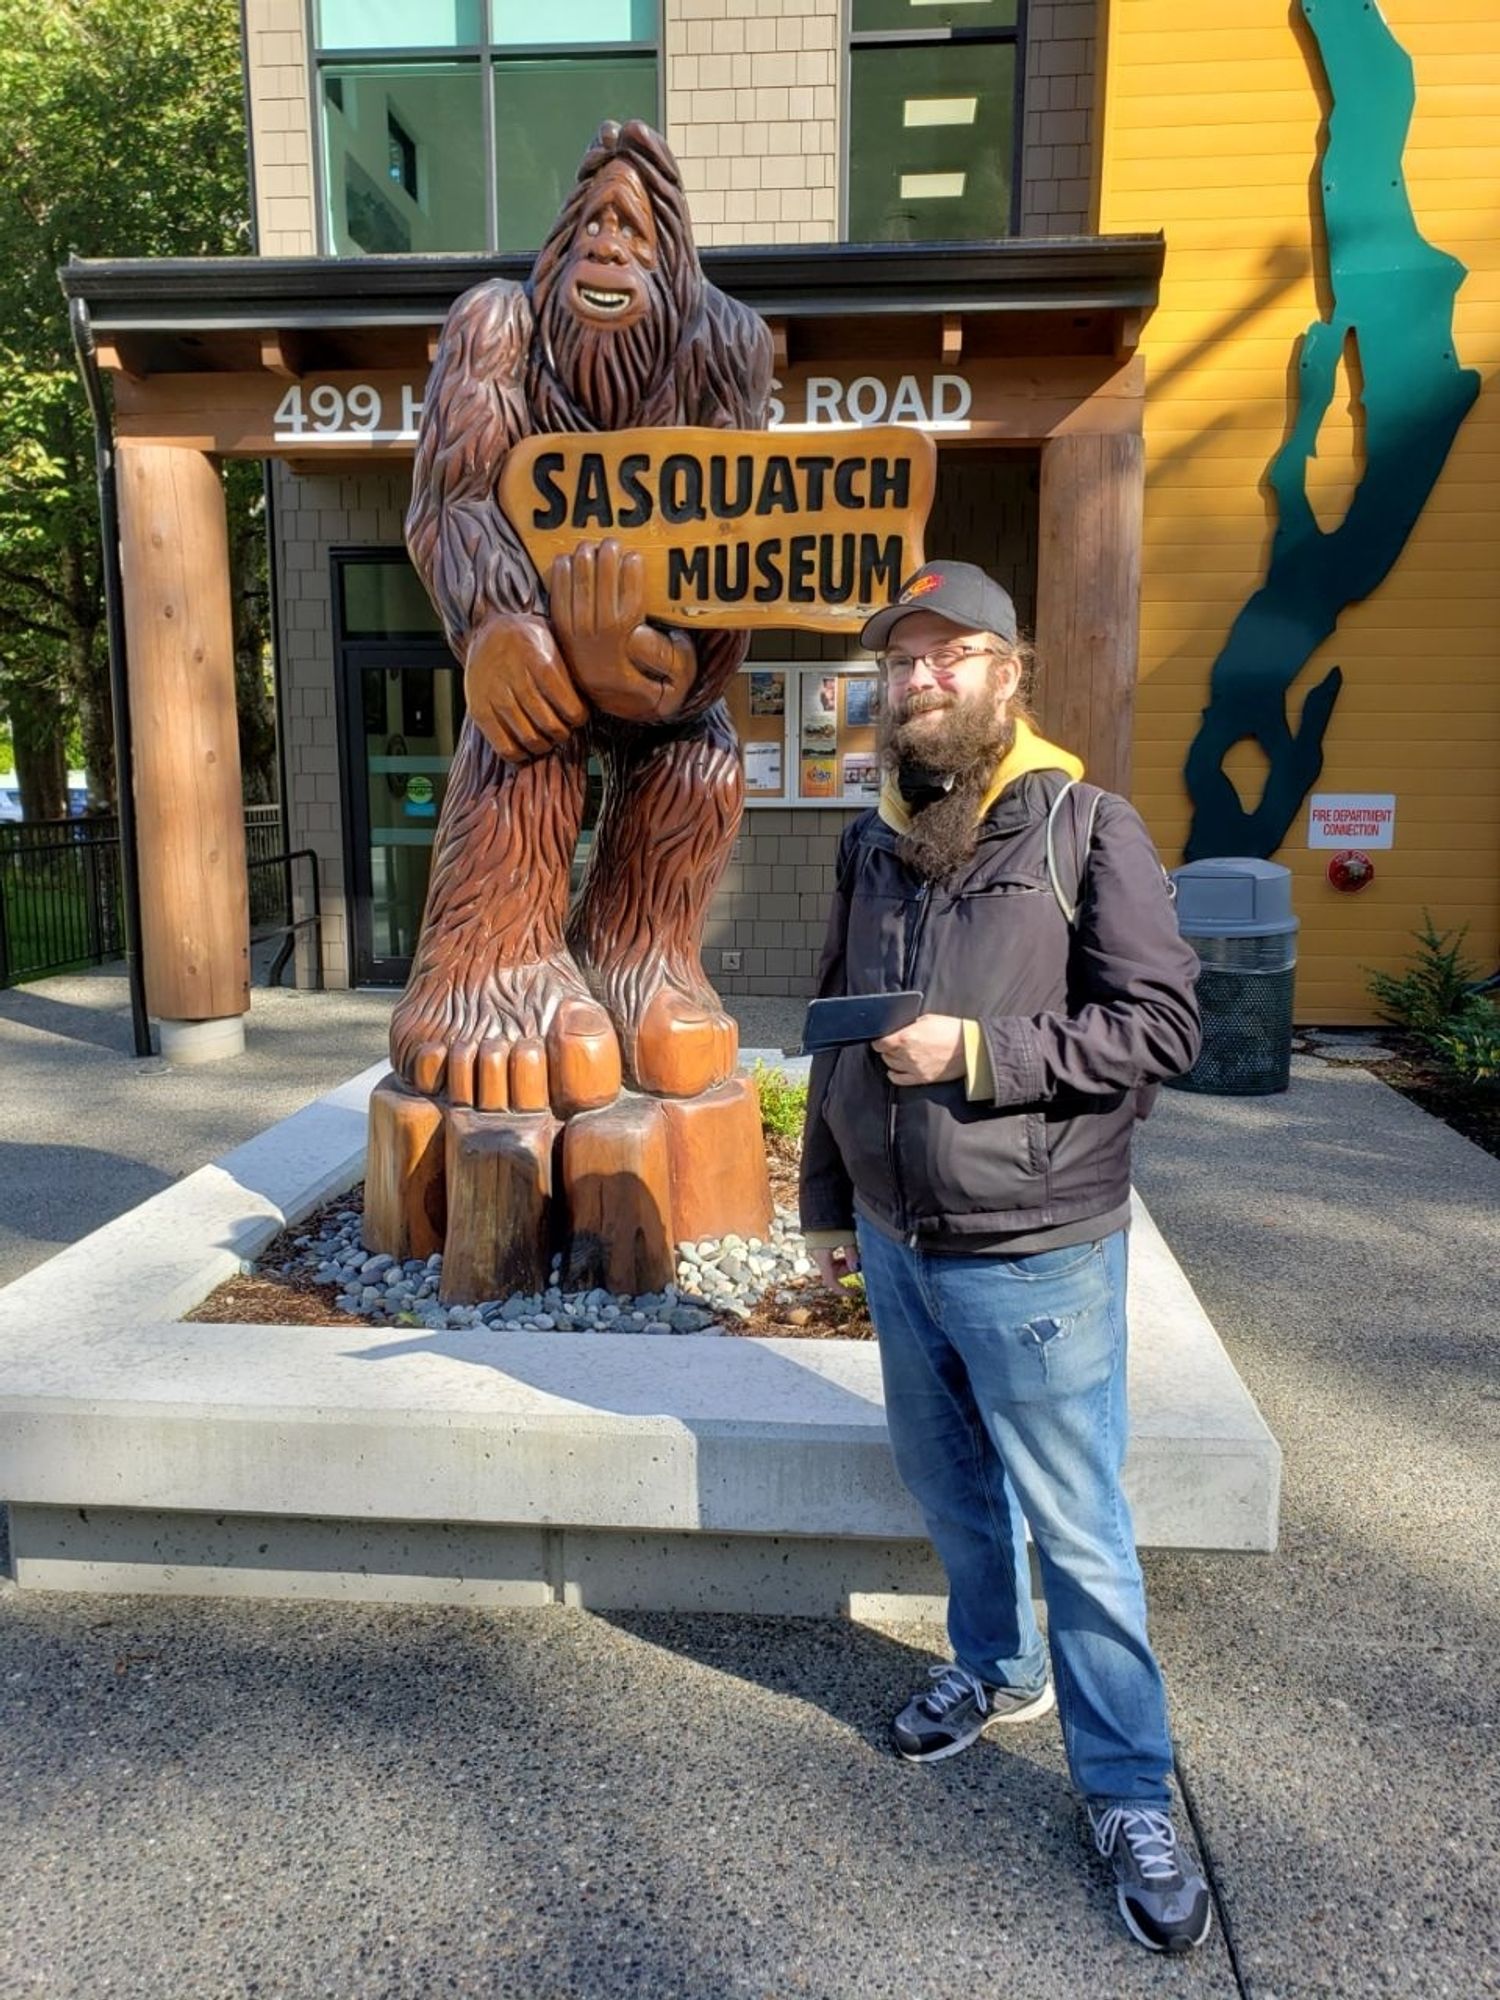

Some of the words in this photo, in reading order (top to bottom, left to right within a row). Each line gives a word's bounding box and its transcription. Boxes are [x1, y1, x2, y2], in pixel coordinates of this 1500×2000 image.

[274, 385, 381, 433] 499
[806, 375, 972, 425] ROAD
[532, 452, 911, 530] SASQUATCH
[667, 533, 904, 604] MUSEUM
[1312, 809, 1332, 822] FIRE
[1333, 809, 1392, 823] DEPARTMENT
[1323, 823, 1379, 836] CONNECTION
